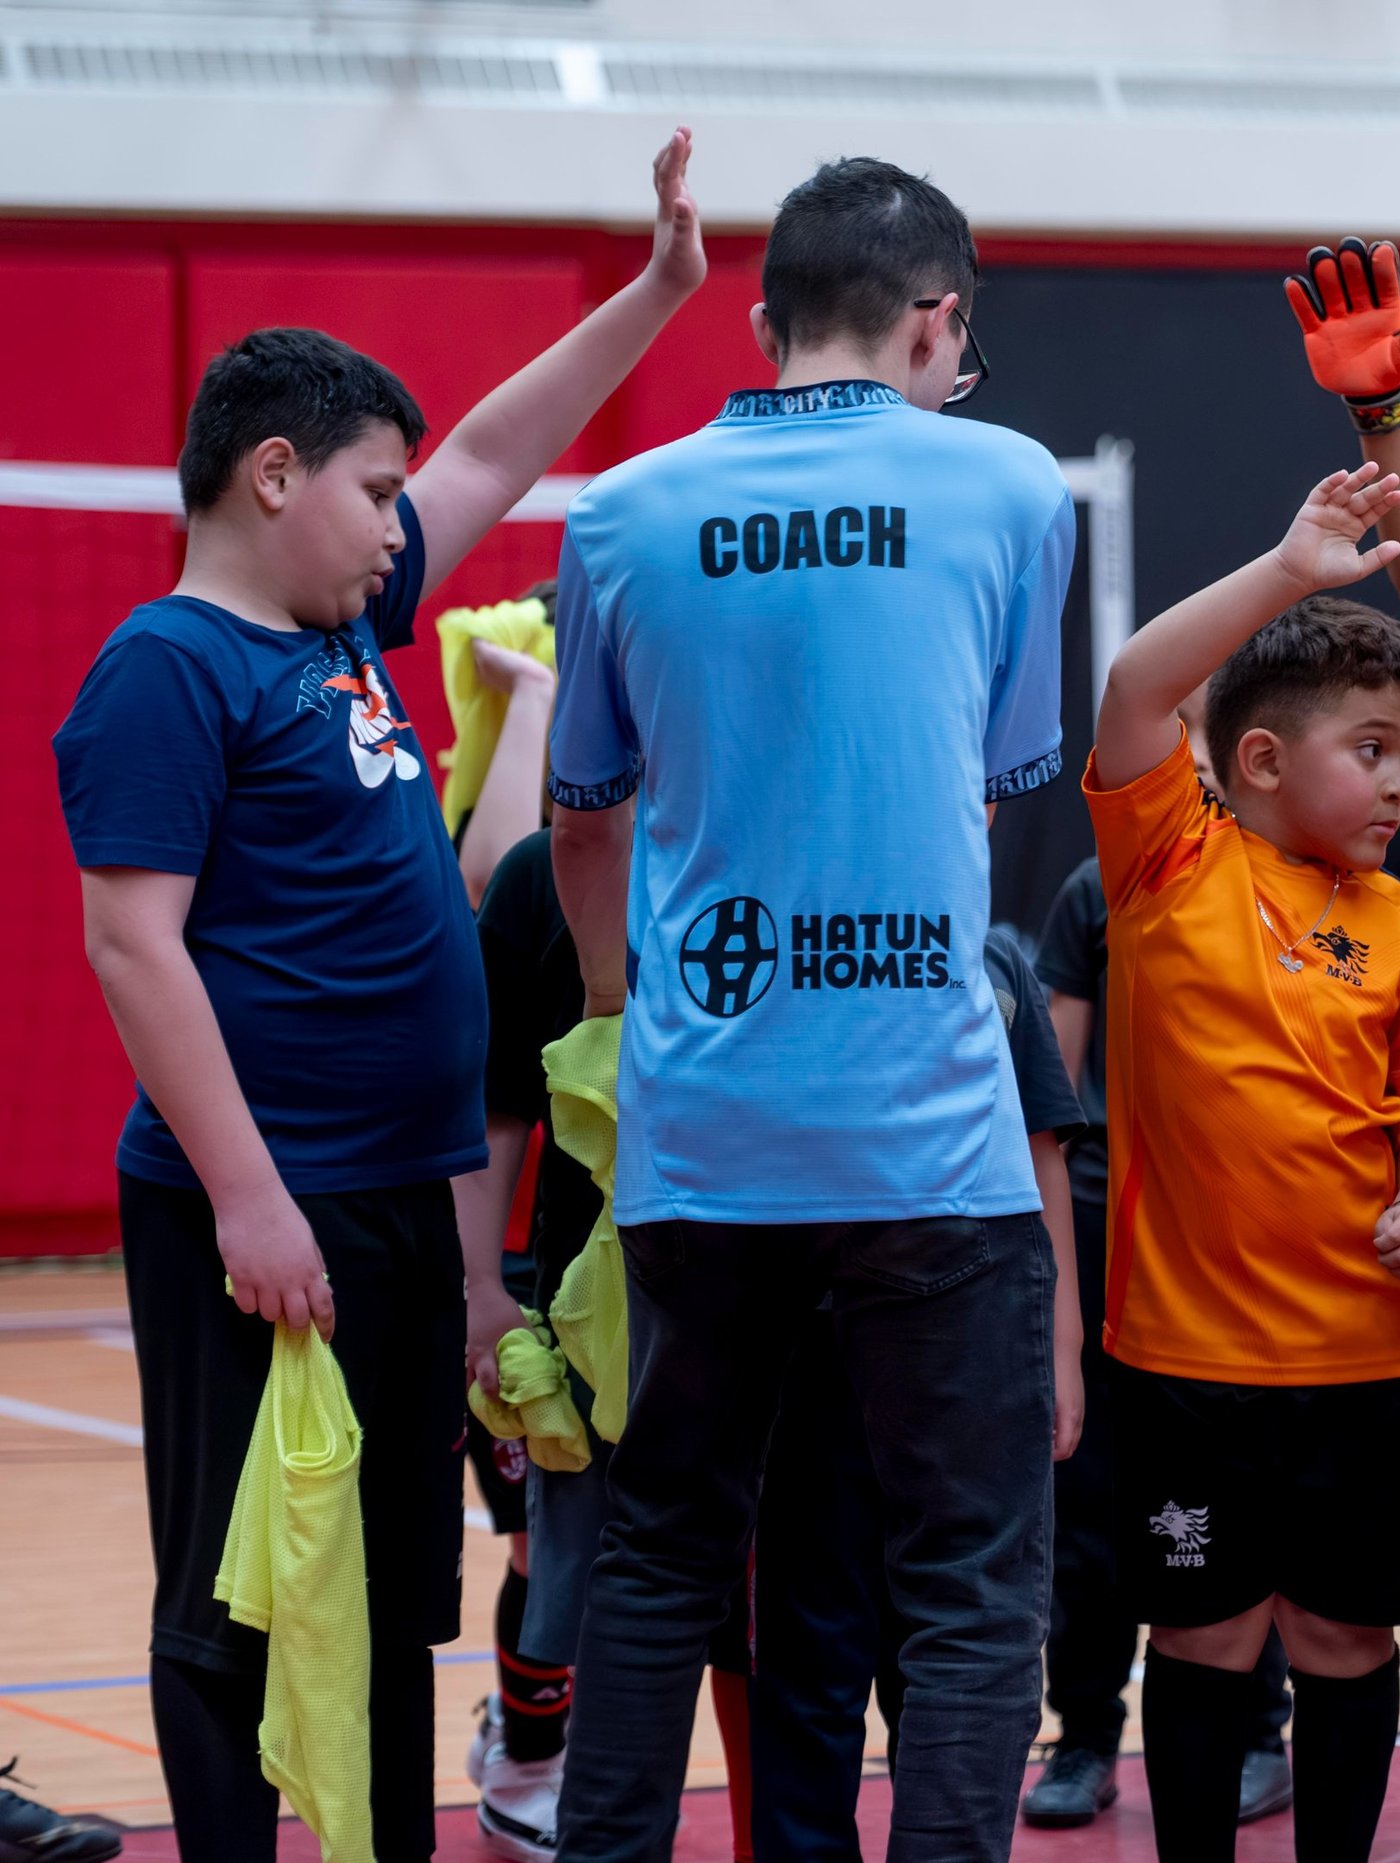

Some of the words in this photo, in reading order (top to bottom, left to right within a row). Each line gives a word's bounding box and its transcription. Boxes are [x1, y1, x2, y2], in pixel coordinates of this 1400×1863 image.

[699, 505, 906, 578] COACH
[791, 914, 950, 951] HATUN
[791, 952, 949, 990] HOMES
